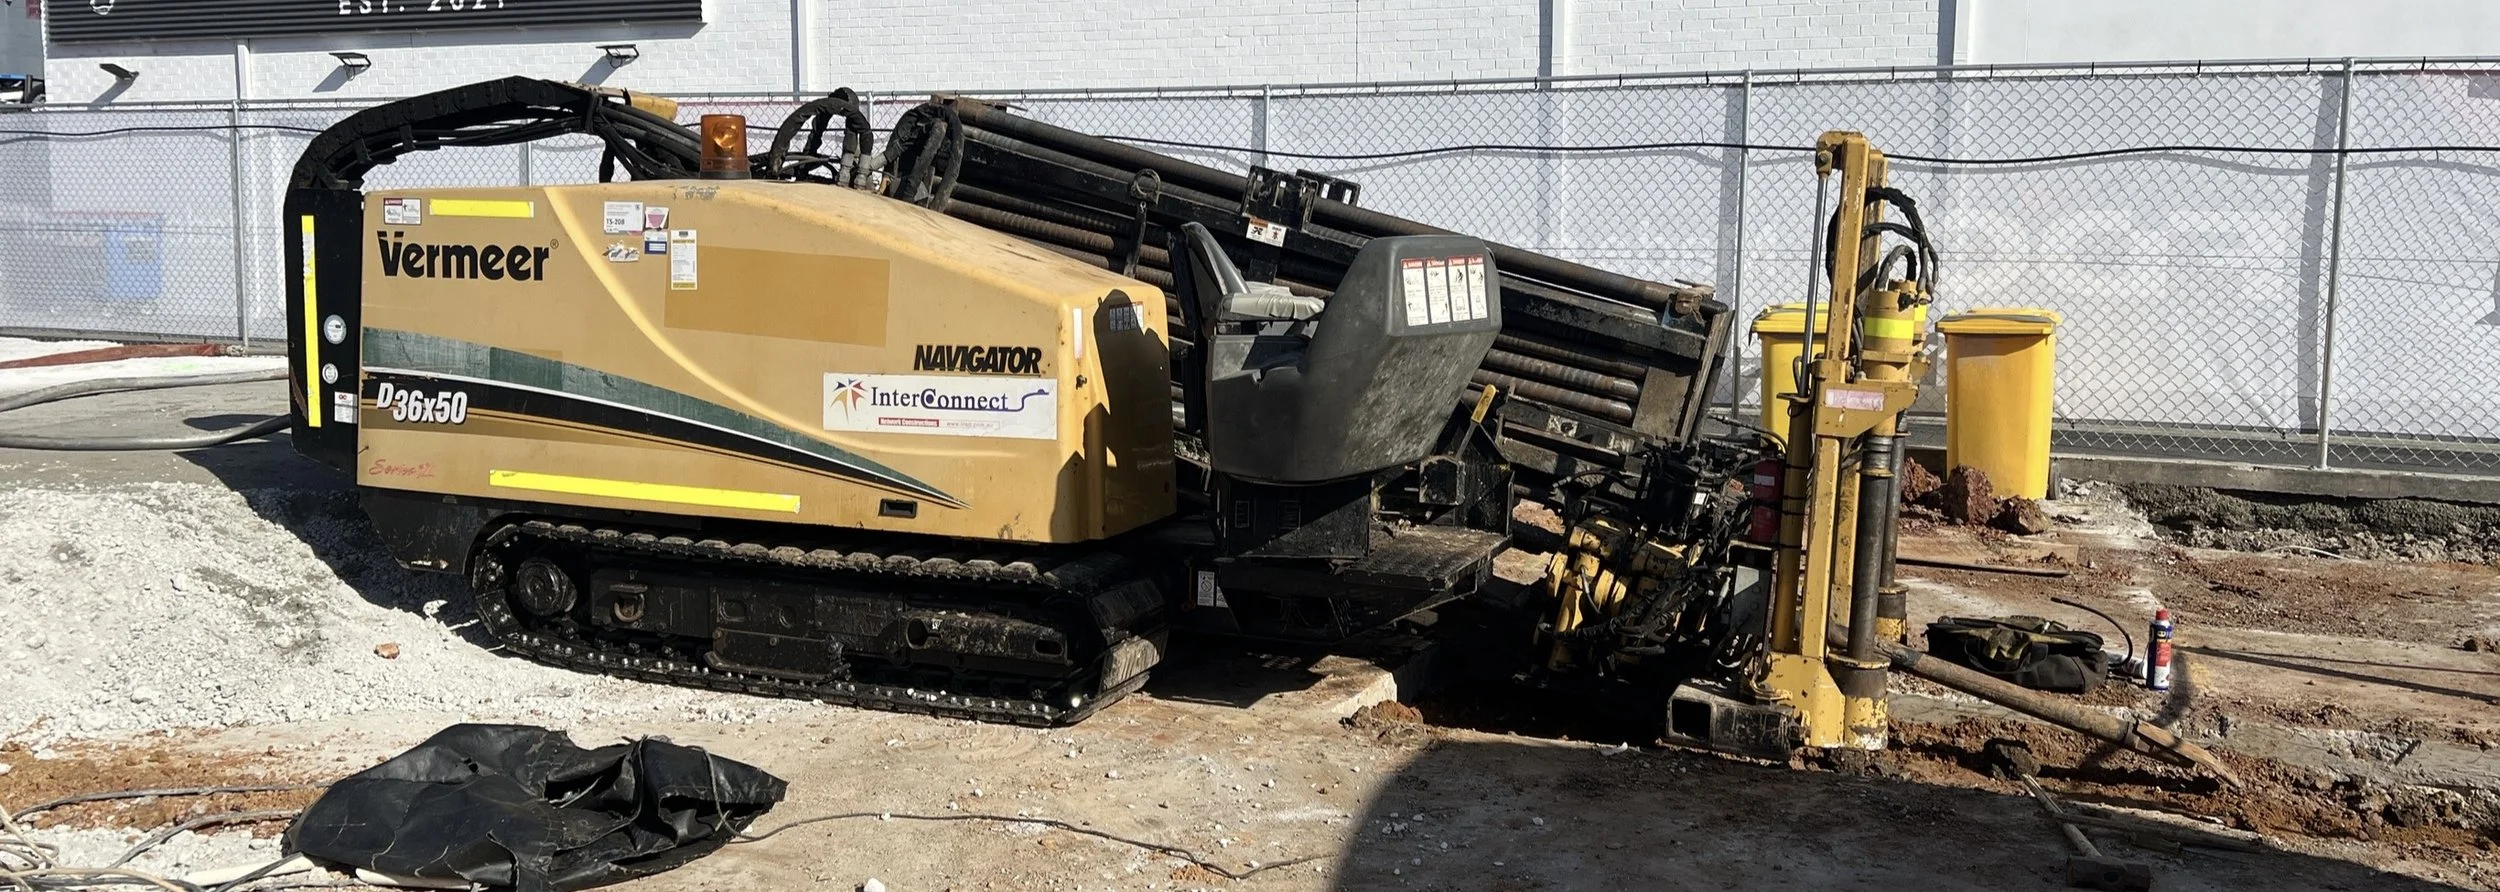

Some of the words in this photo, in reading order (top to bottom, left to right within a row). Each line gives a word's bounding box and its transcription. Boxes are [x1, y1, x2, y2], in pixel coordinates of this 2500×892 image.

[377, 231, 549, 281] Vermeer
[914, 345, 1042, 374] NAVIGATOR
[377, 382, 468, 424] D36x50
[871, 387, 1009, 411] InterConnect
